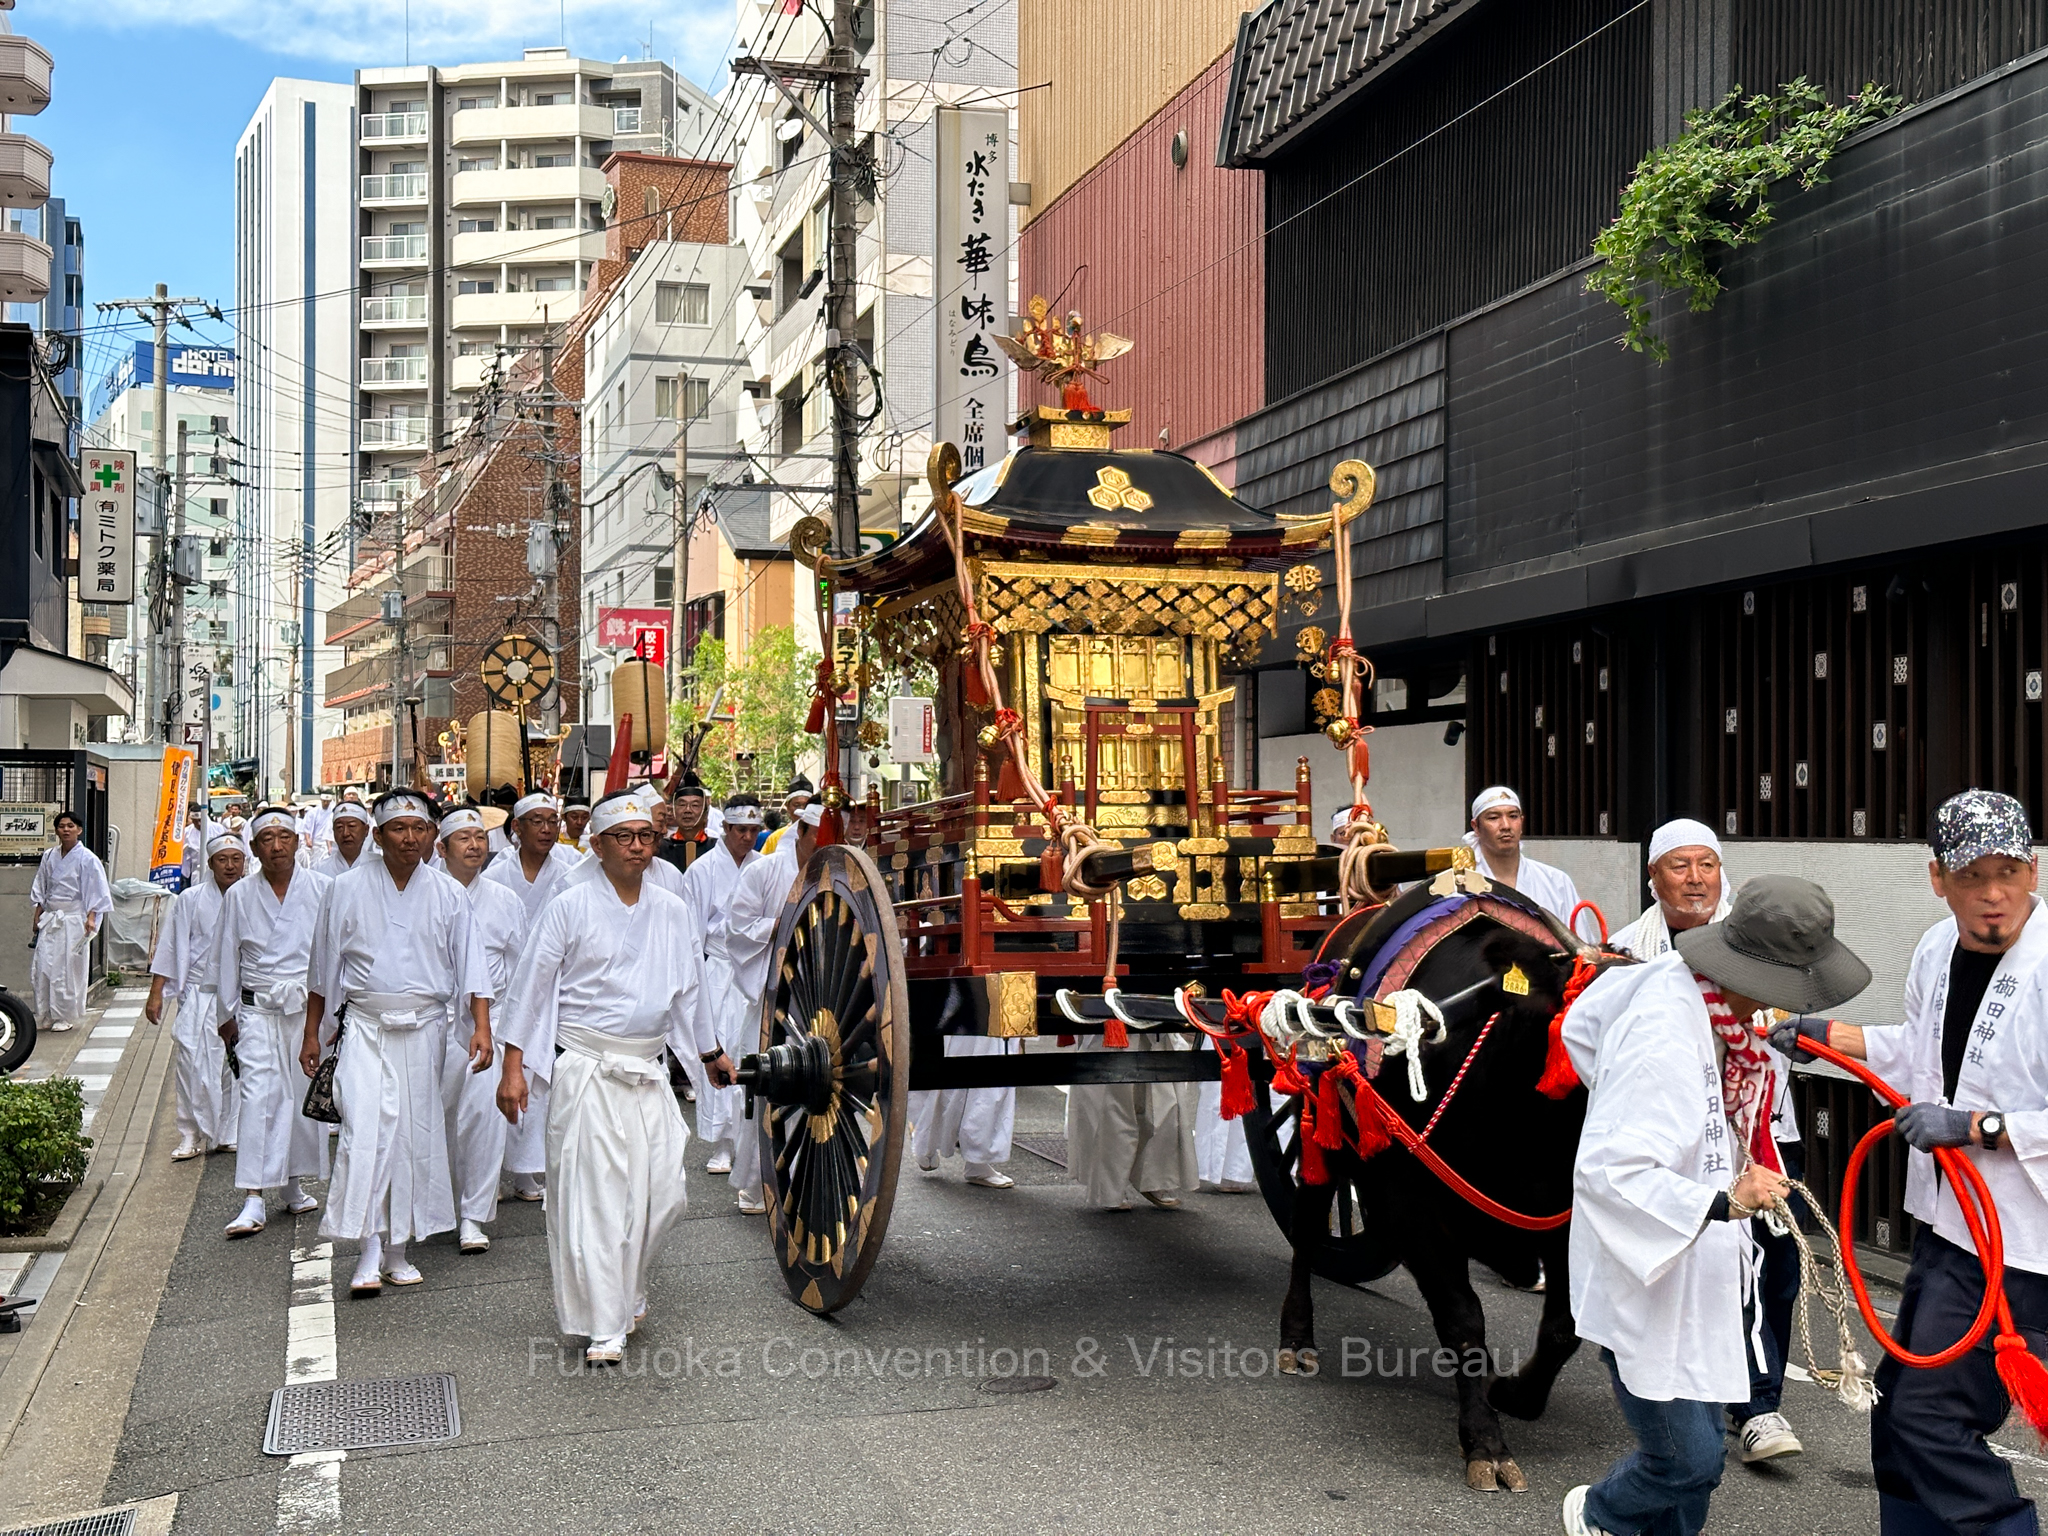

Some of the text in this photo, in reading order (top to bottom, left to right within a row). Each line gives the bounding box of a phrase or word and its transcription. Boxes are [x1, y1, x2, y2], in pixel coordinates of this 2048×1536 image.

[984, 133, 999, 165] 博多
[187, 349, 230, 361] HOTEL
[948, 309, 958, 357] はなみどり
[963, 397, 985, 473] 全席個
[1966, 972, 2019, 1069] 櫛田神社
